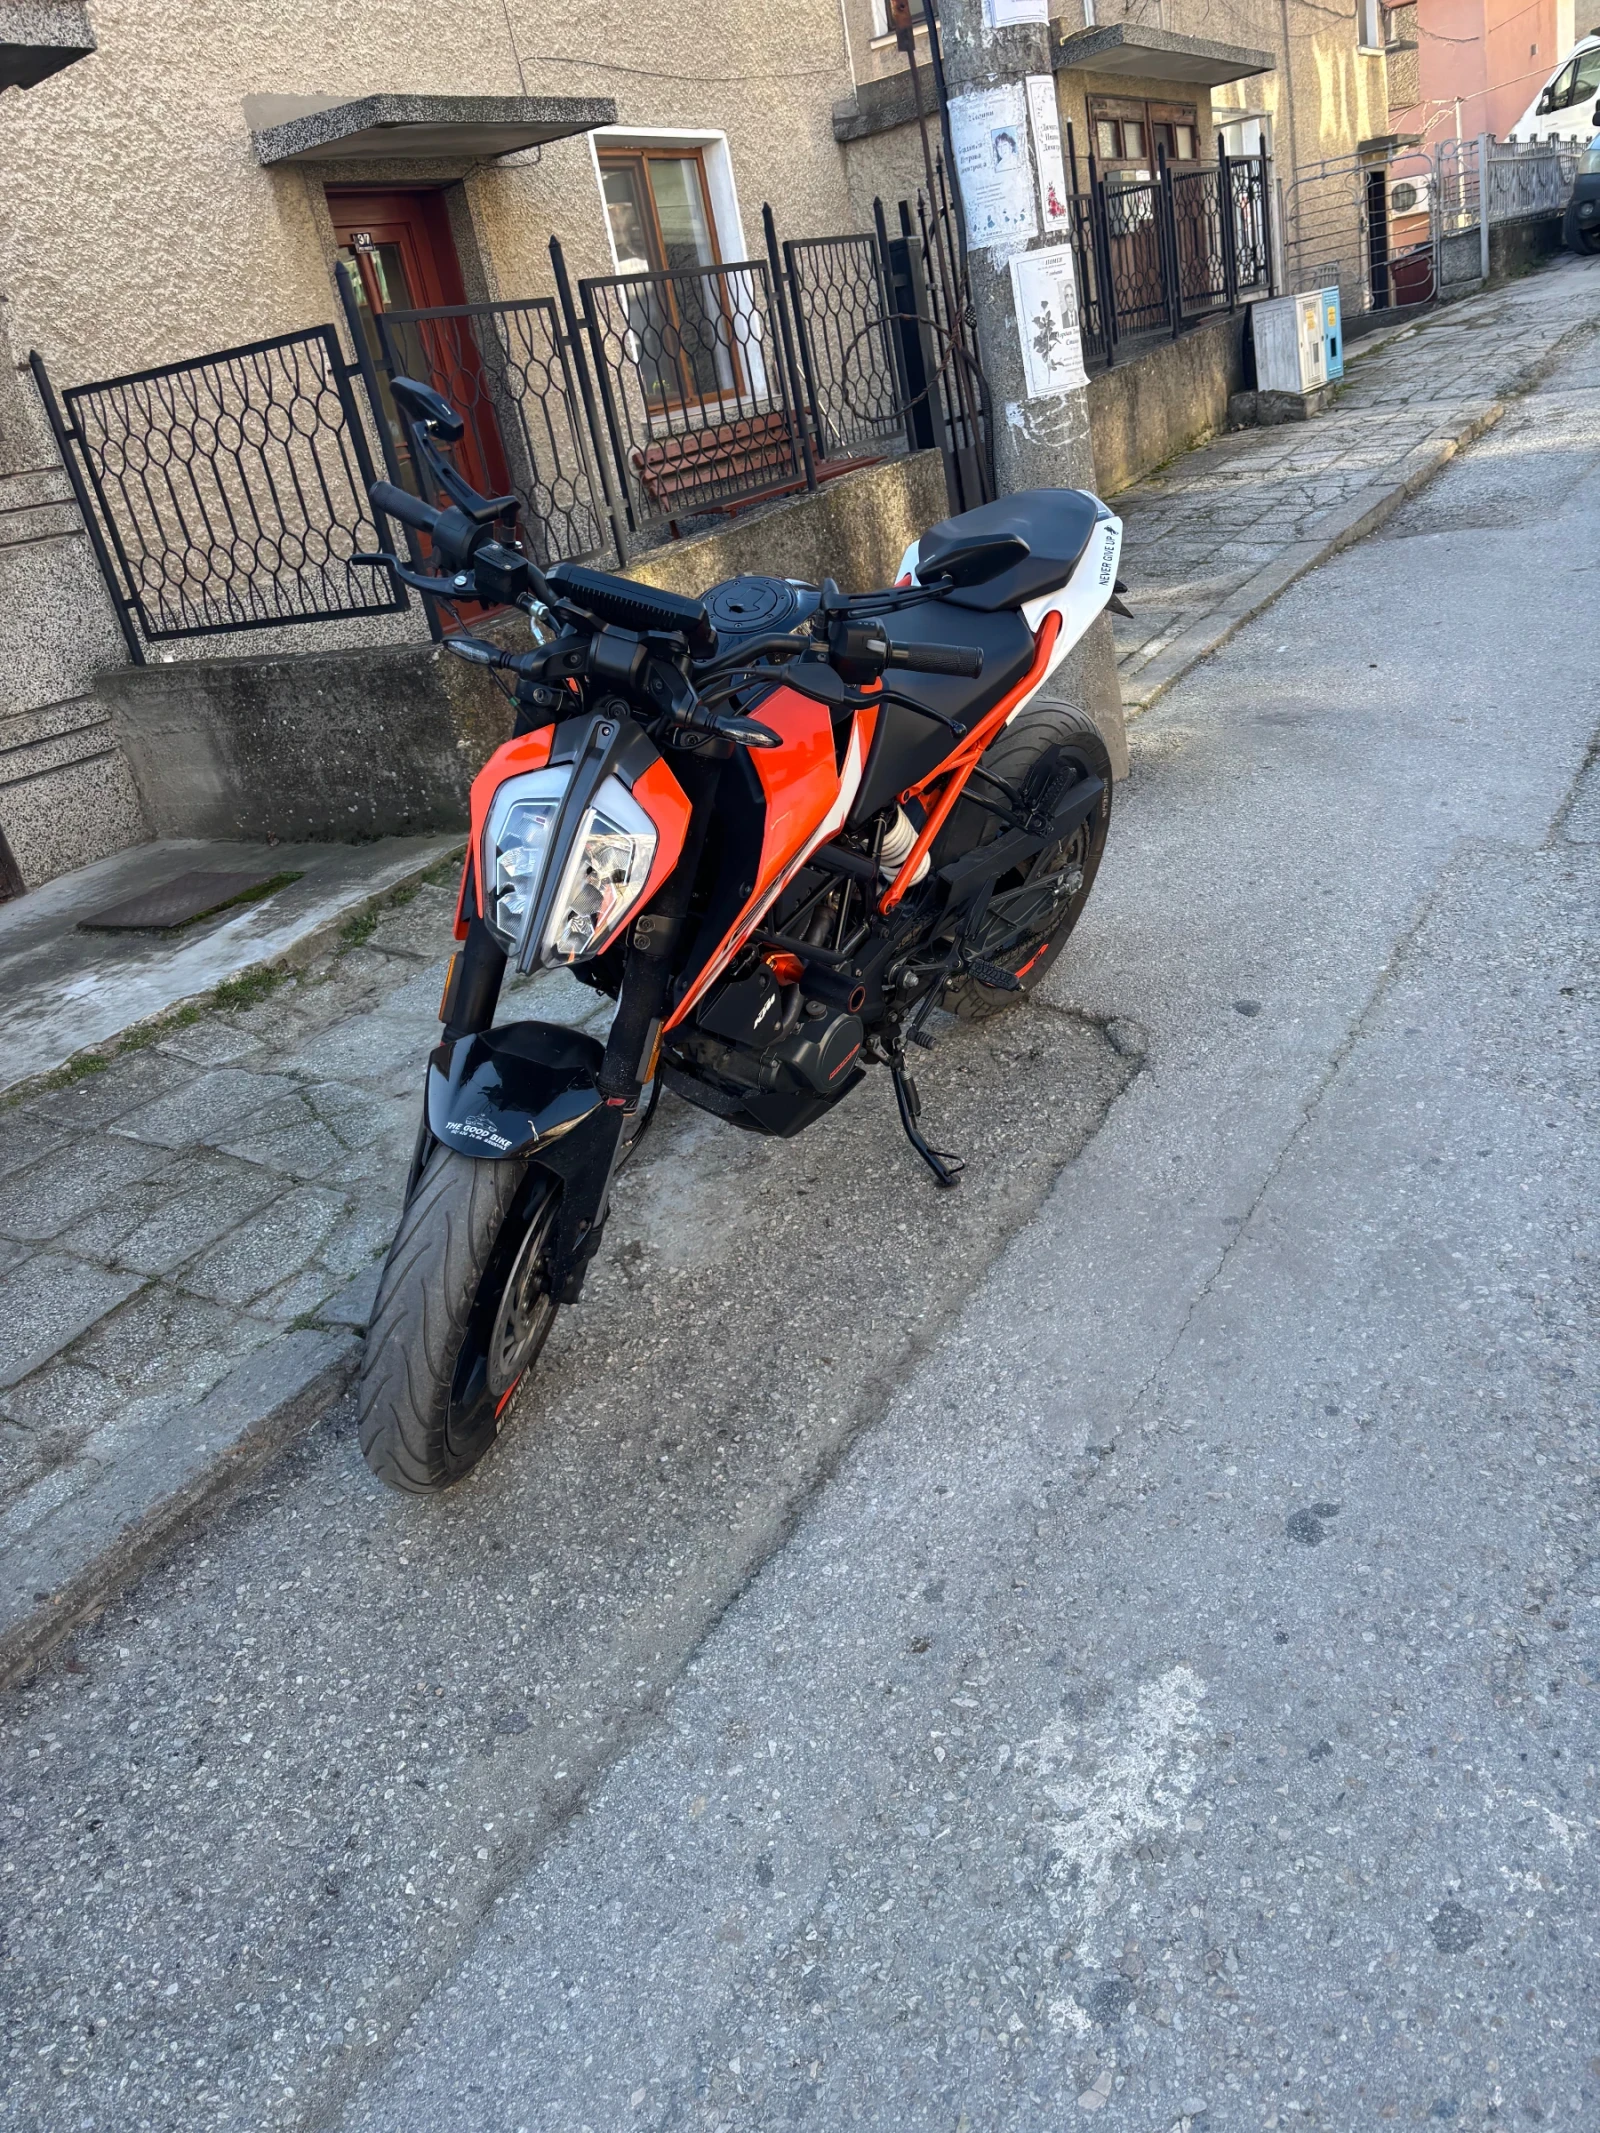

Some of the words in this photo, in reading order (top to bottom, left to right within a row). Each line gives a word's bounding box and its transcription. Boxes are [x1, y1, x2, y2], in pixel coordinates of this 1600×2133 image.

[357, 233, 370, 245] 37
[1105, 535, 1116, 545] UP
[1103, 546, 1115, 561] GIVE
[1098, 562, 1112, 586] NEVER
[463, 1125, 490, 1137] GOOD
[490, 1133, 513, 1147] BIKE
